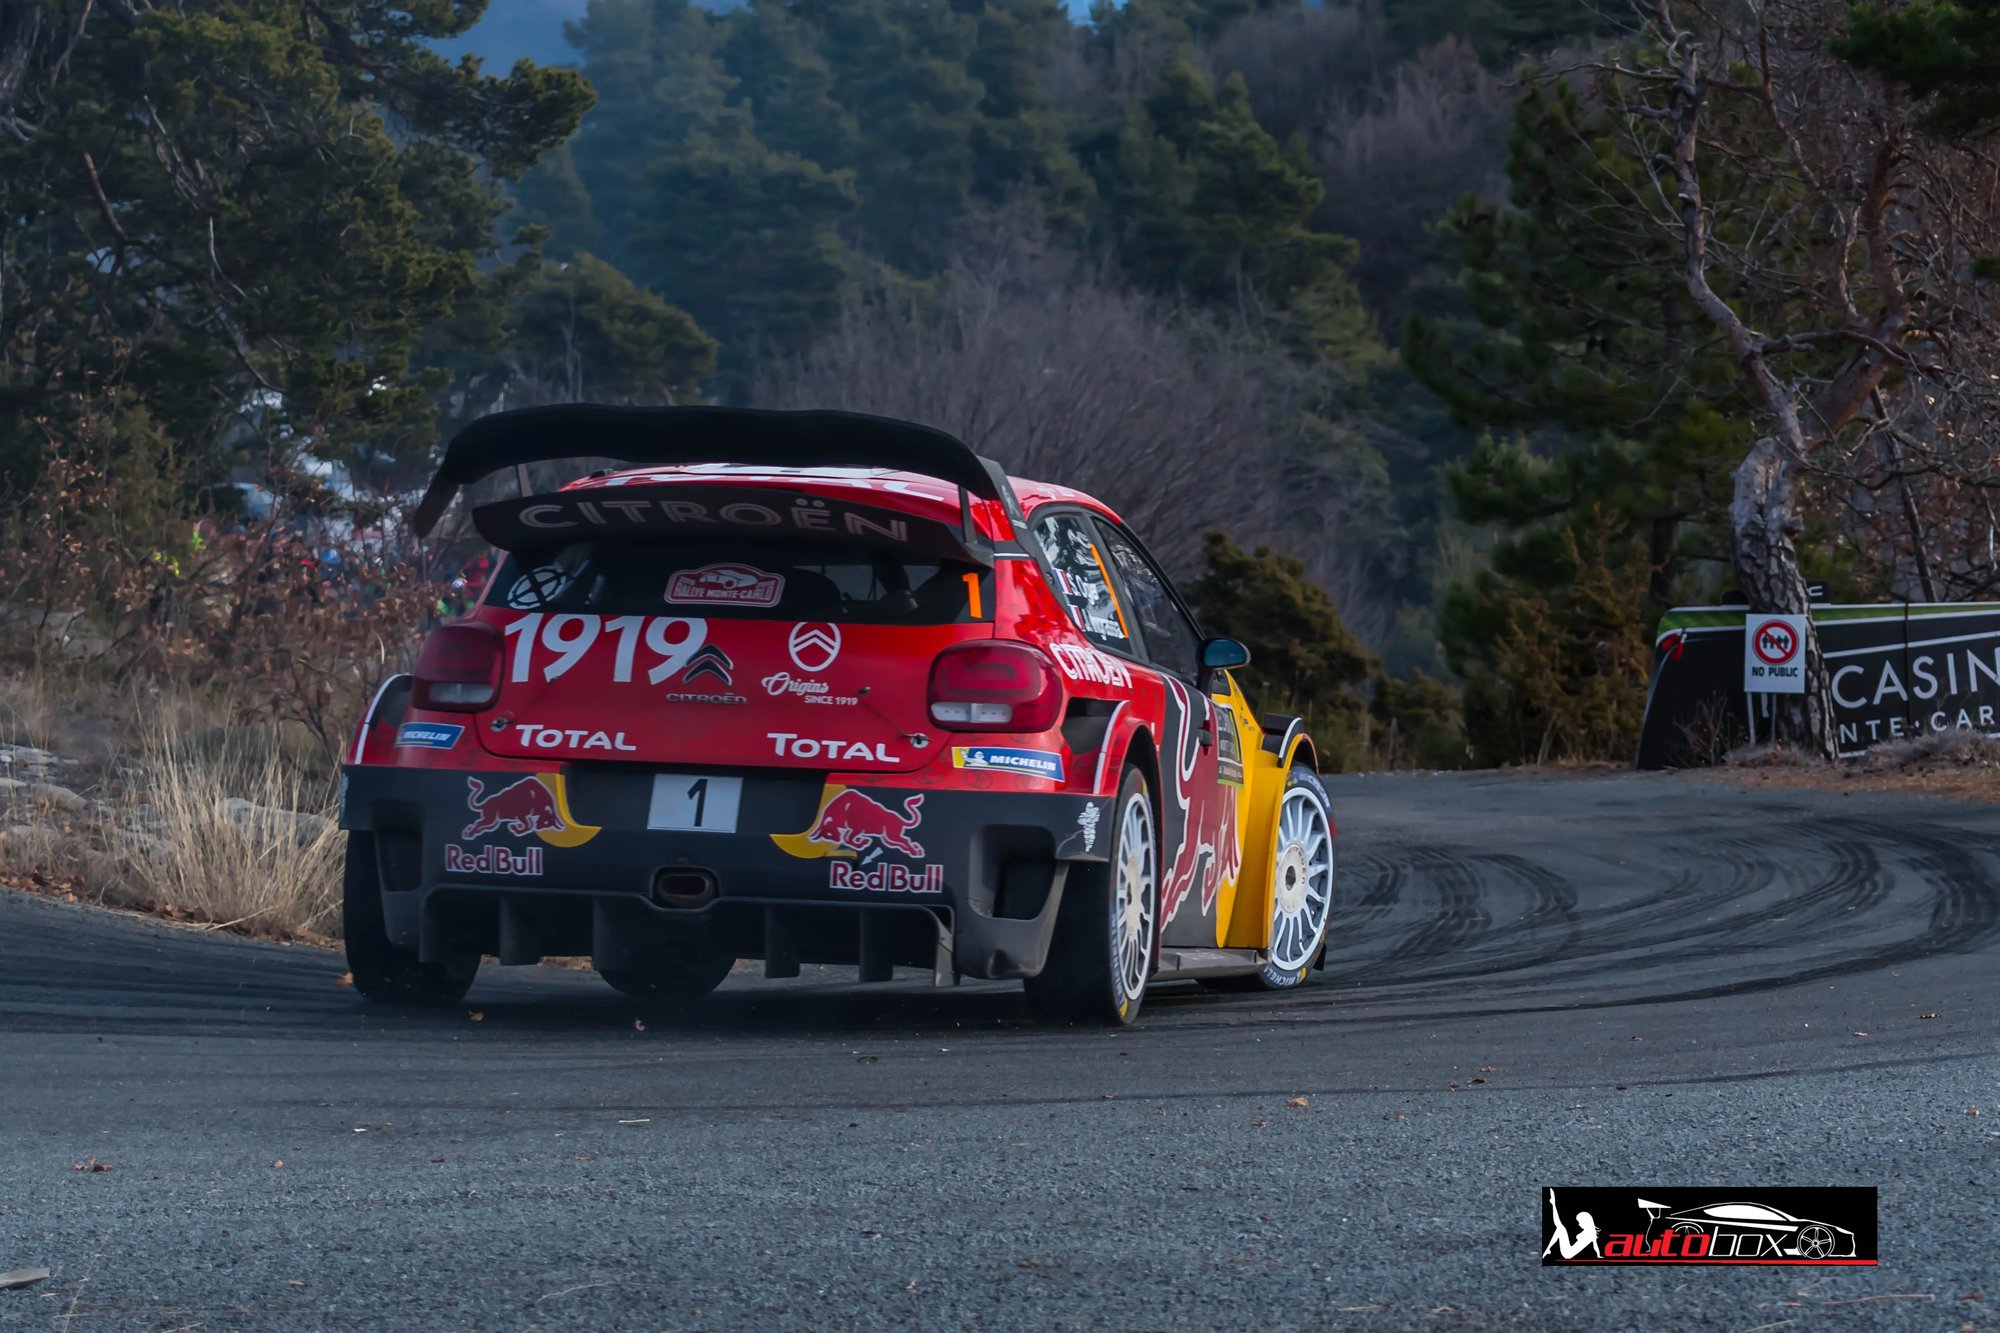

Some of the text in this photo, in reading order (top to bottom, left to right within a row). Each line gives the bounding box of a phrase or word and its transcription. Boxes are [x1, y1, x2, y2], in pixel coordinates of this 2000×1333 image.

[519, 498, 908, 542] CITROËN
[962, 572, 982, 619] 1
[505, 612, 708, 685] 1919
[761, 671, 829, 695] Origins
[1752, 666, 1798, 677] NO PUBLIC
[804, 695, 858, 705] SINCE 1919
[515, 724, 637, 750] TOTAL
[767, 732, 900, 763] TOTAL
[990, 755, 1056, 771] MICHELIN
[687, 779, 708, 827] 1
[445, 844, 543, 875] Red Bull
[830, 860, 943, 893] Red Bull
